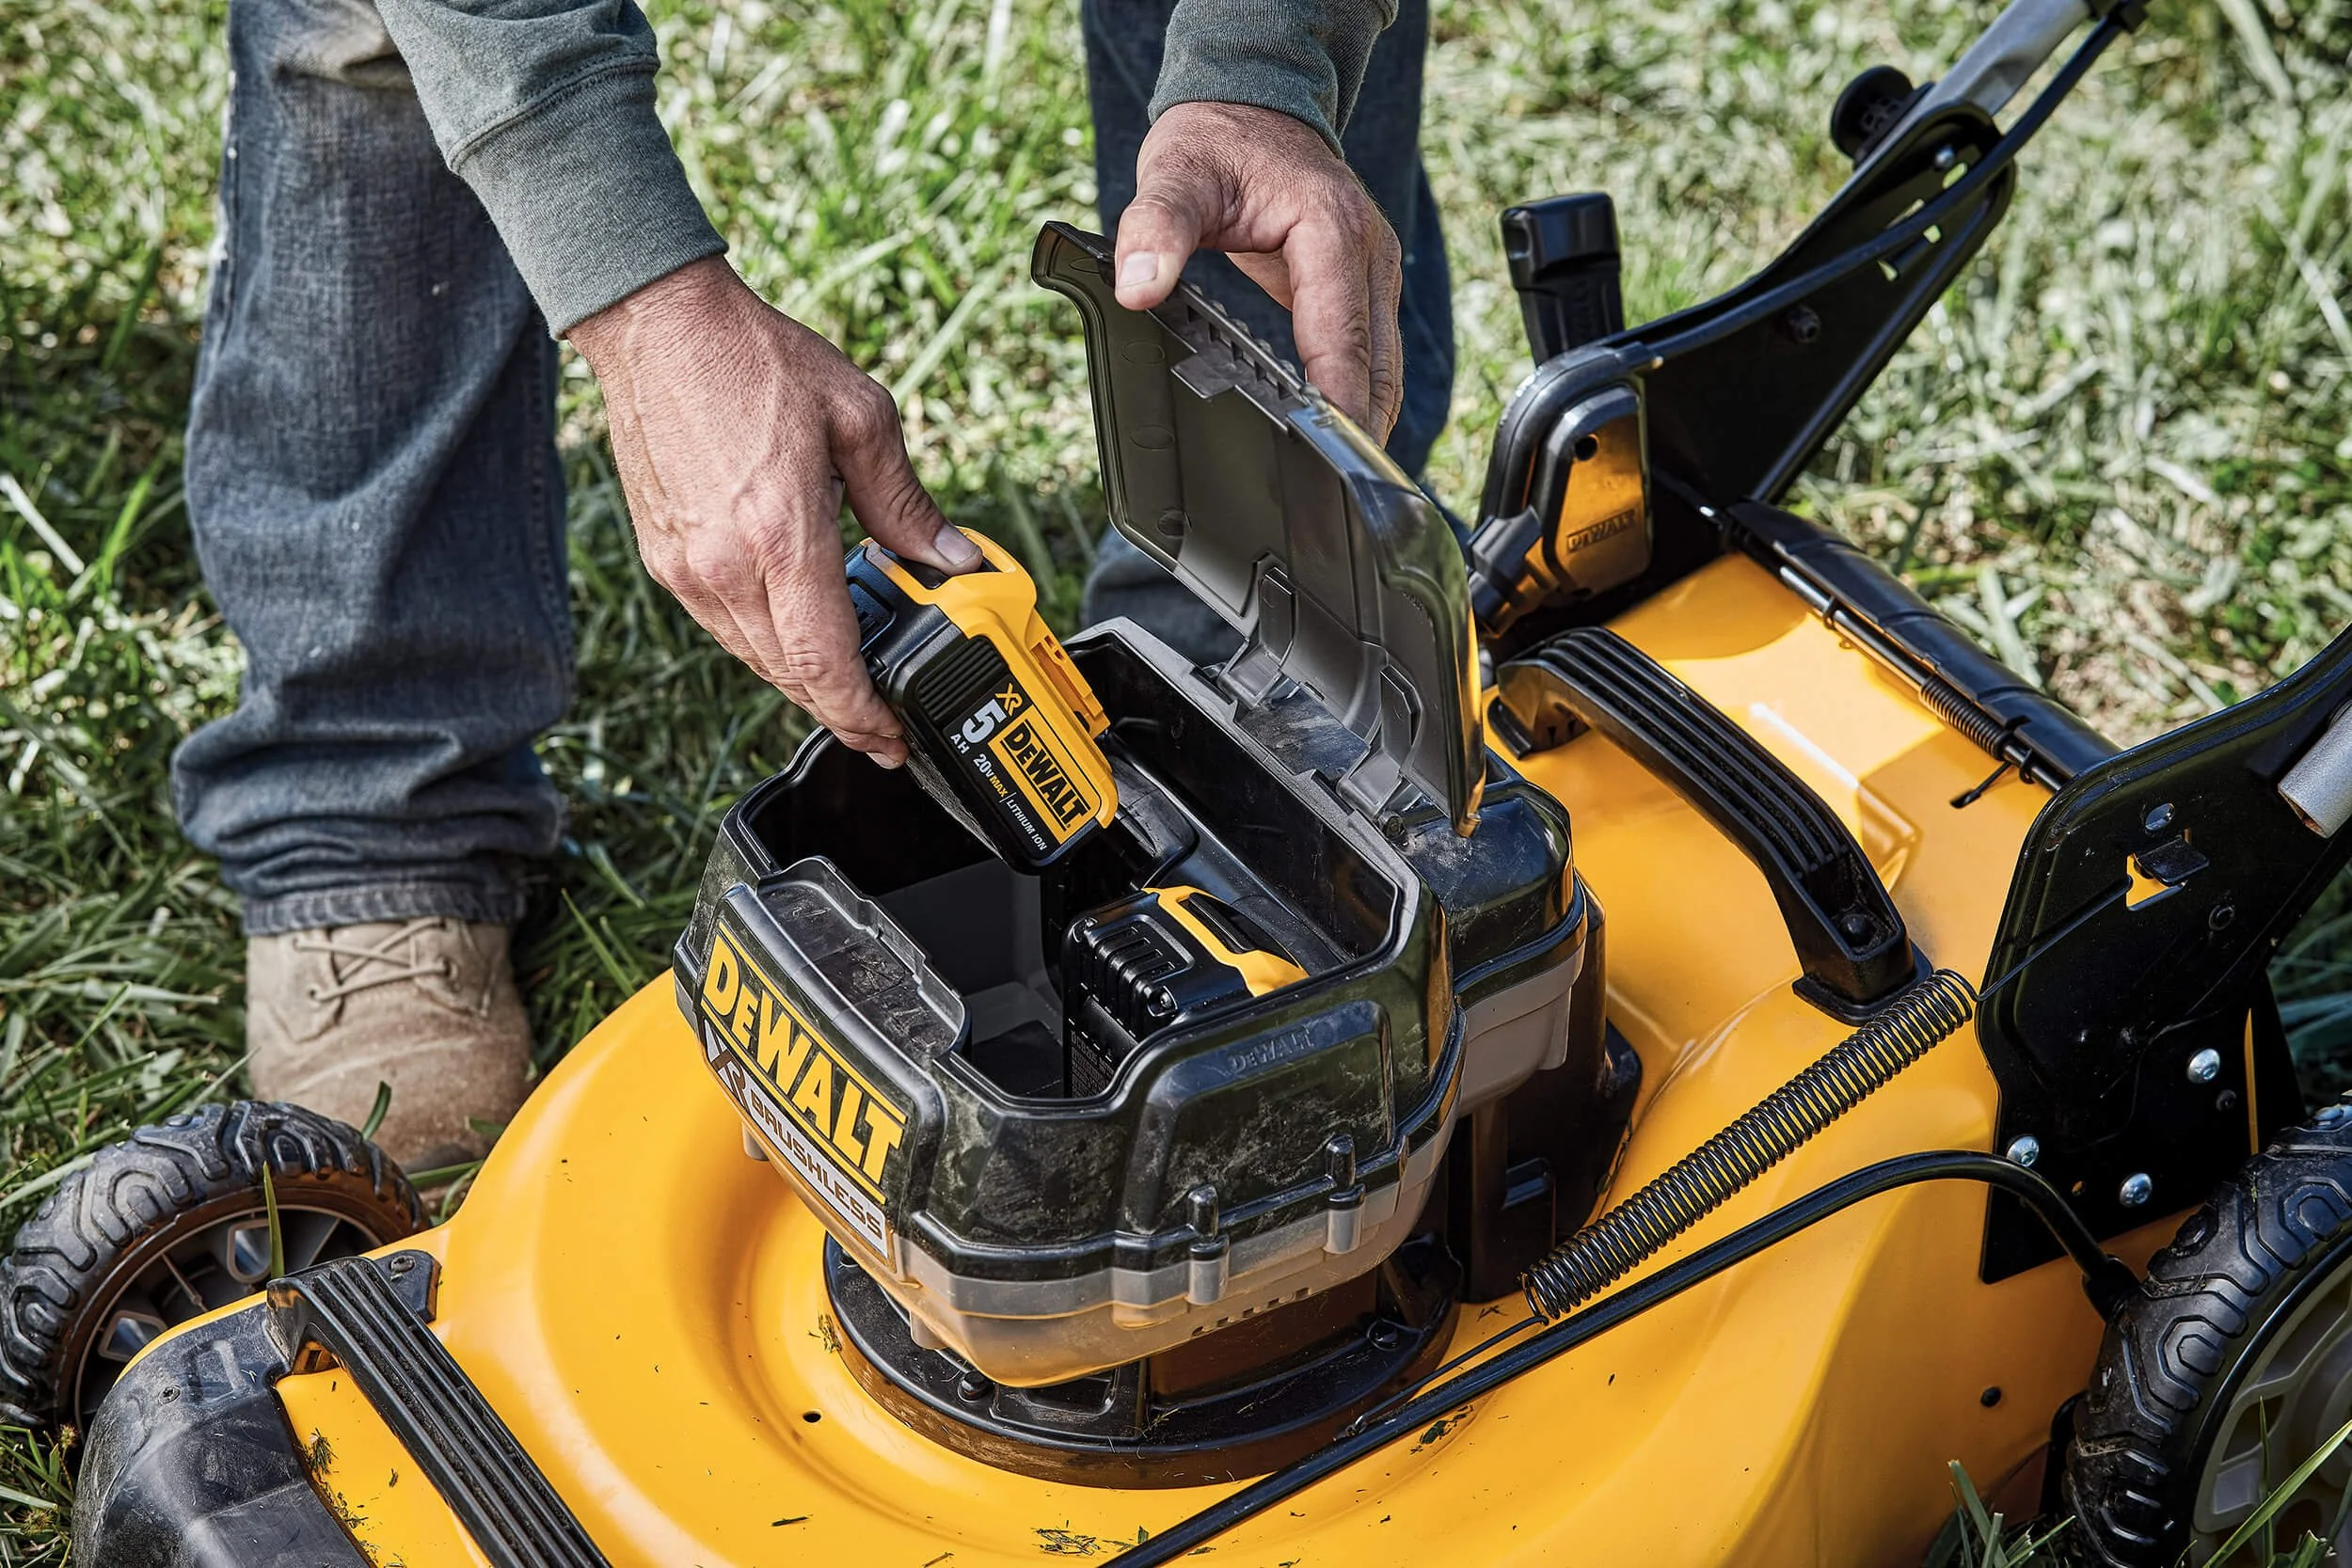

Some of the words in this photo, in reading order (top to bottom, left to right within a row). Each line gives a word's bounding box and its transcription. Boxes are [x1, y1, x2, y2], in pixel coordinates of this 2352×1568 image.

[961, 698, 1008, 743] 5
[994, 682, 1024, 717] XR
[950, 734, 970, 754] AH
[1004, 721, 1089, 825] DEWALT
[1006, 799, 1036, 837] LITHIUM
[1031, 833, 1047, 851] ION
[704, 933, 904, 1185] DEWALT
[750, 1088, 882, 1241] BRUSHLESS
